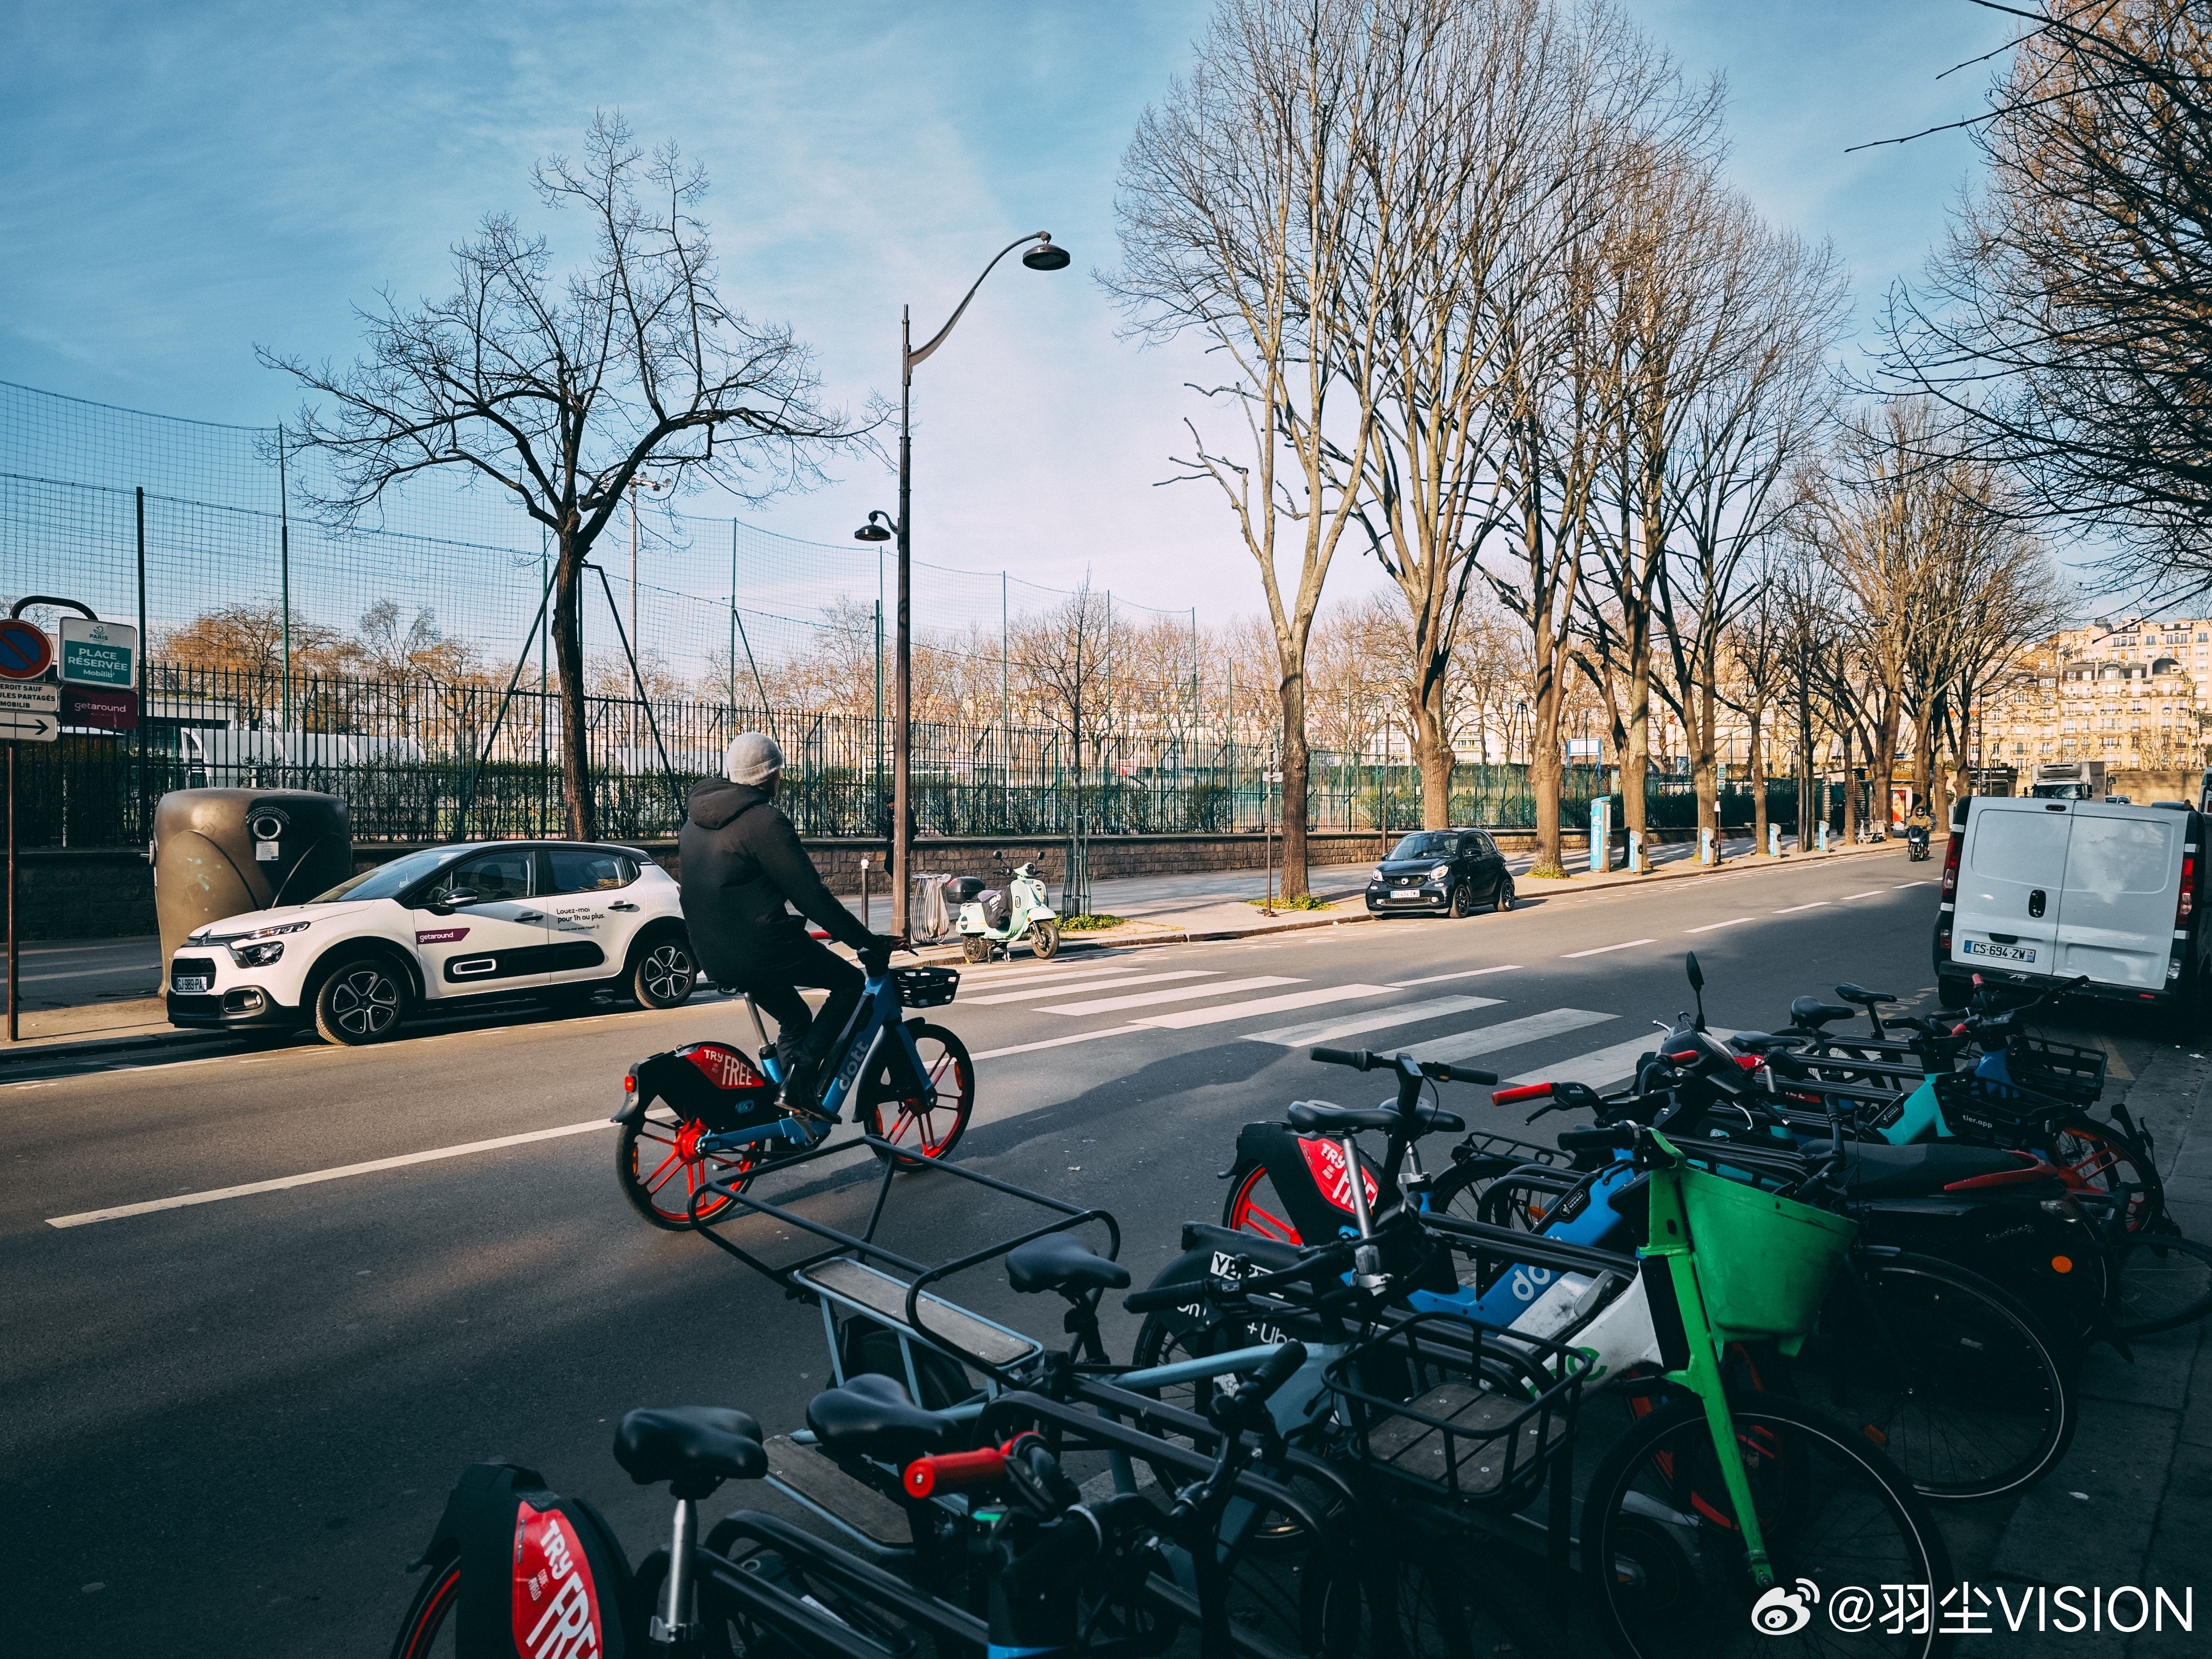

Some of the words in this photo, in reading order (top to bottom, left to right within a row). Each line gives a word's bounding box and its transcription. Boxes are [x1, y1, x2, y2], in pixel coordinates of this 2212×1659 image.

[79, 648, 117, 660] PLACE
[68, 656, 128, 671] RÉSERVÉE
[18, 693, 56, 702] PARTAGÉS
[75, 703, 126, 712] getaround
[420, 932, 454, 942] getaround
[1973, 943, 2025, 960] CS-694-ZW
[704, 1049, 724, 1063] TRY
[722, 1055, 752, 1085] FREE
[839, 1041, 869, 1090] dott
[1963, 1115, 1992, 1129] tier.app
[1321, 1142, 1346, 1169] TRY
[1260, 1323, 1304, 1344] Ub
[540, 1519, 574, 1580] TRY
